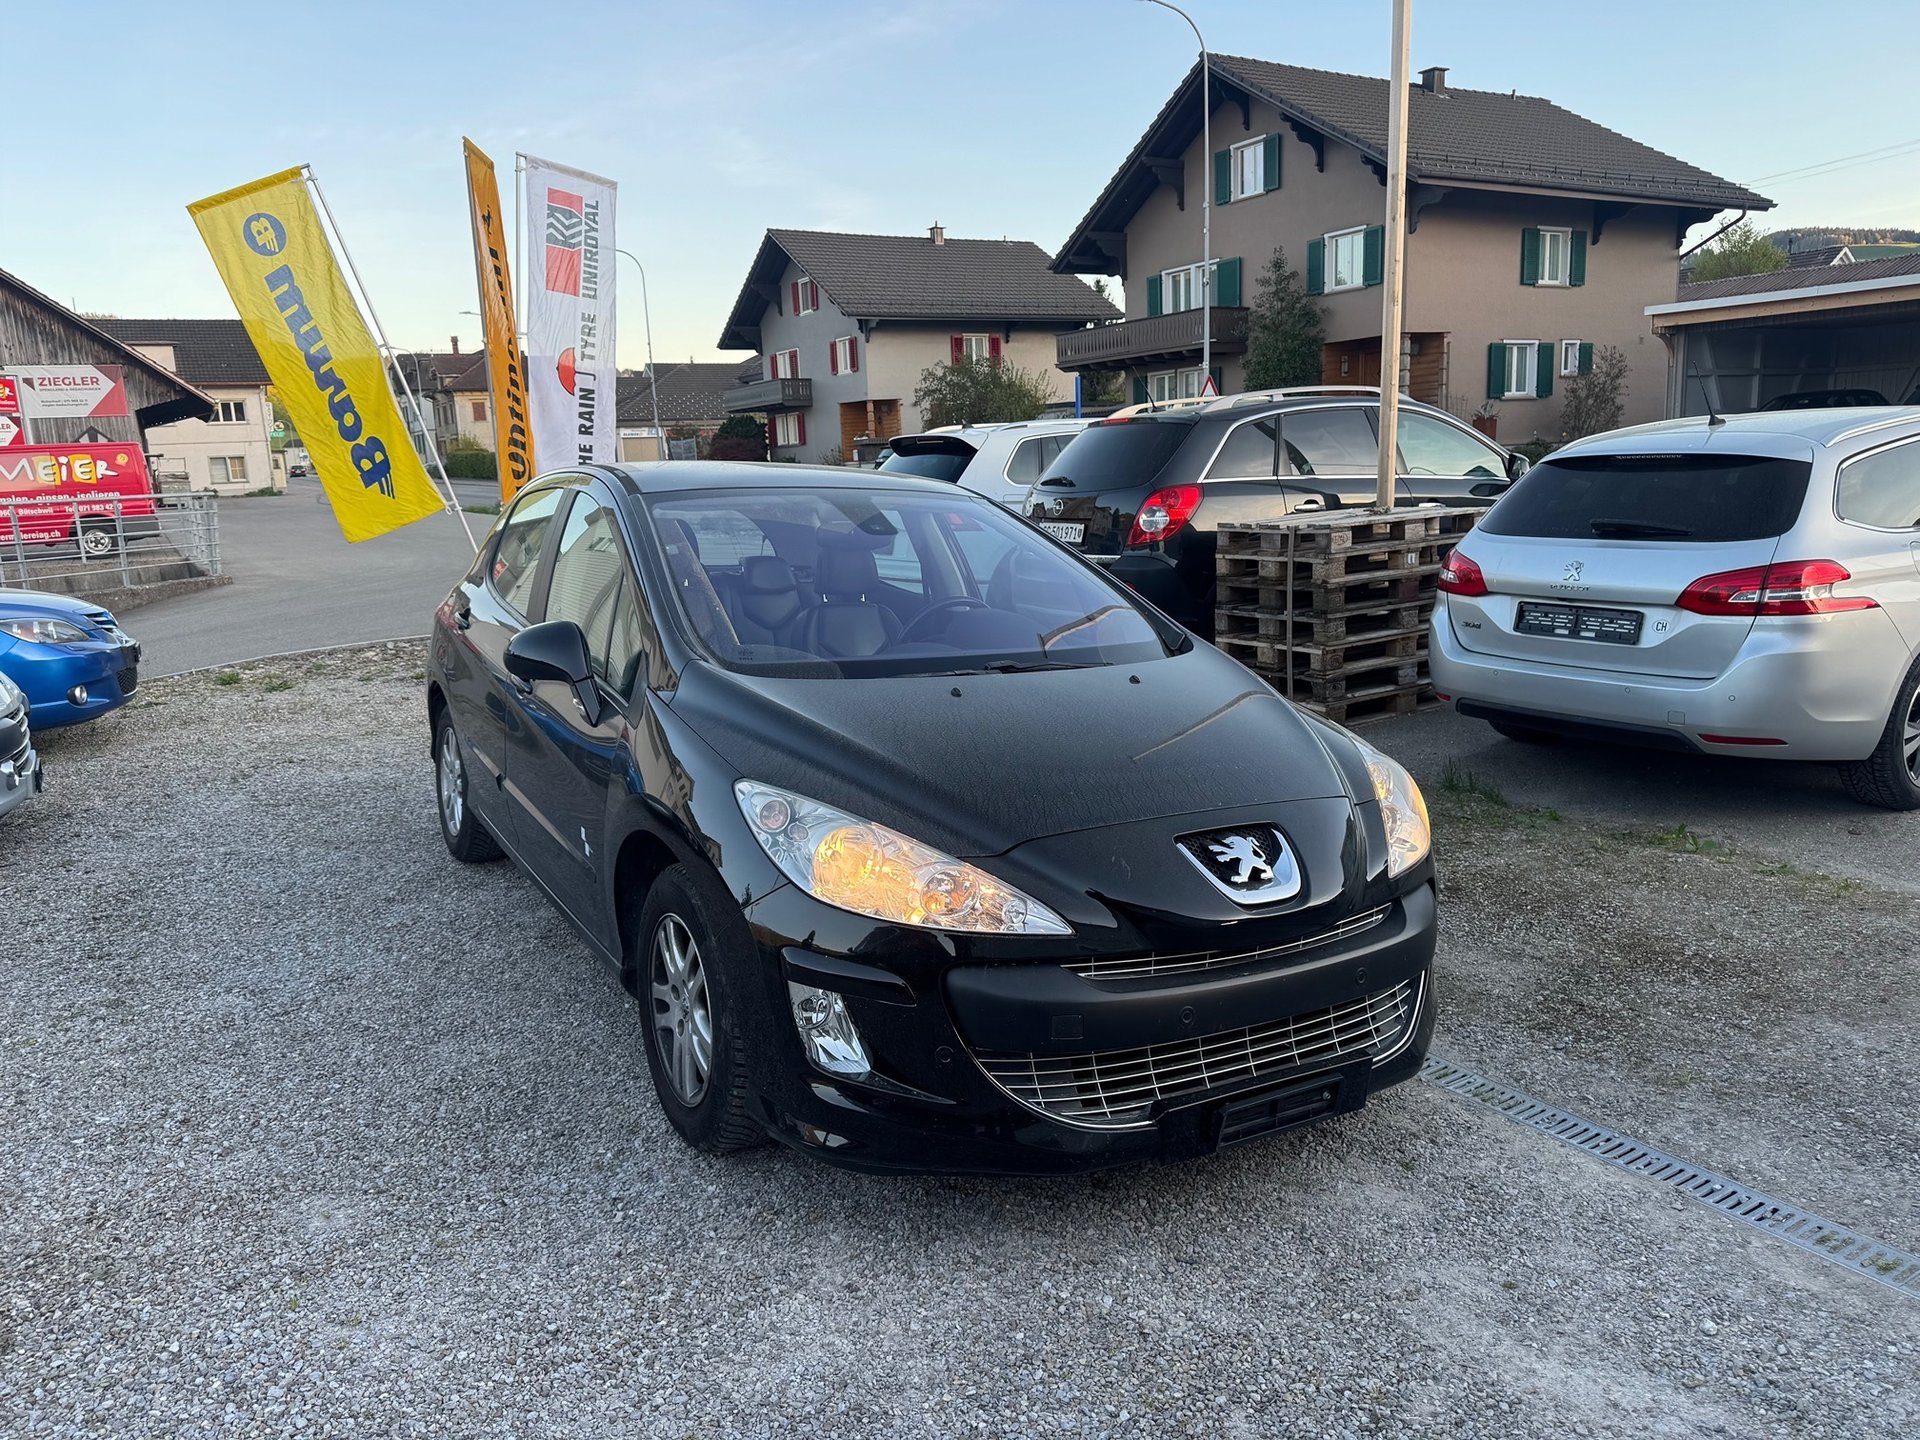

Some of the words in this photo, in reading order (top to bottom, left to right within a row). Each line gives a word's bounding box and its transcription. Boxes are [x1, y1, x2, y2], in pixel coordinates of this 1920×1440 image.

[582, 200, 600, 300] UNIROYAL
[581, 312, 597, 361] TYRE
[37, 376, 100, 387] ZIEGLER
[578, 387, 595, 437] RAIN
[578, 443, 593, 466] HE
[1655, 621, 1668, 632] CH
